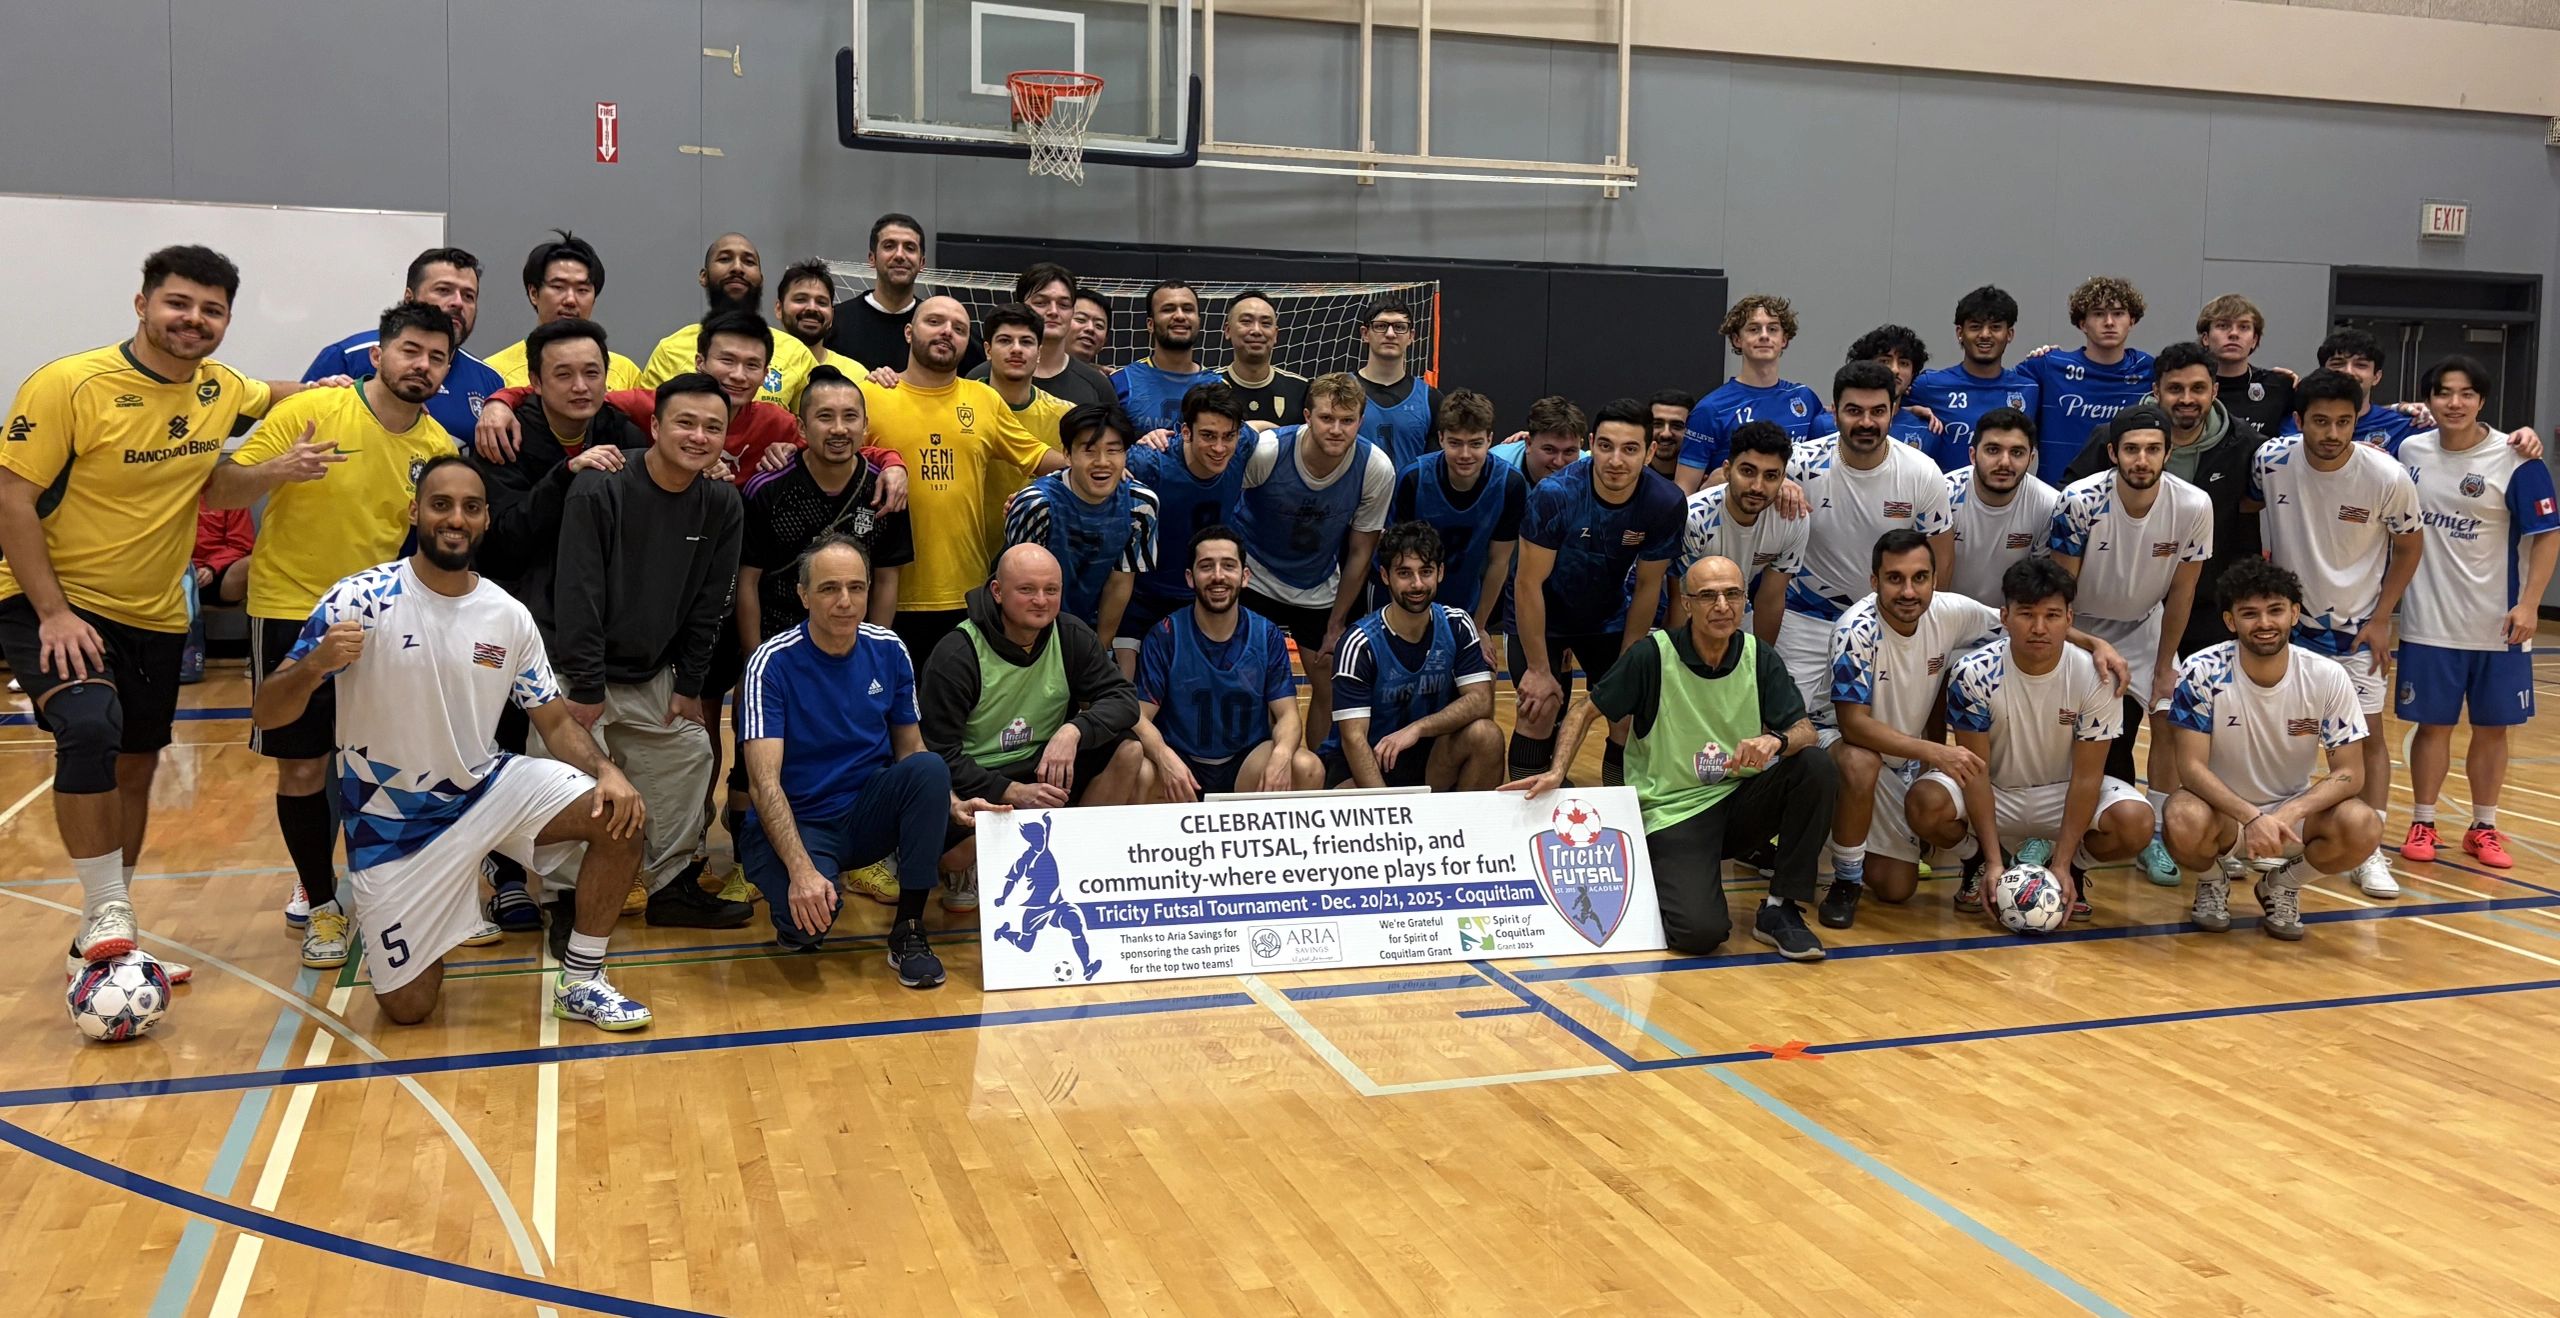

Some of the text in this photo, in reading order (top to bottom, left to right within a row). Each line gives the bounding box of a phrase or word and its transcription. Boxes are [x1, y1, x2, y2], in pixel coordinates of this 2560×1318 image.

[600, 107, 615, 117] FIRE
[2433, 207, 2464, 232] EXIT
[2065, 364, 2085, 380] 30
[1948, 392, 1968, 409] 23
[2059, 394, 2126, 418] Premi
[1735, 406, 1755, 424] 12
[189, 438, 221, 455] BRASIL
[921, 464, 954, 480] RAKI
[2449, 531, 2479, 540] ACADEMY
[1180, 806, 1413, 834] CELEBRATING WINTER
[1128, 829, 1465, 866] through FUTSAL, friendship, and
[1079, 854, 1516, 894] community-where everyone plays for fun!
[1551, 866, 1623, 886] FUTSAL
[1589, 884, 1624, 893] ACADEMY
[1096, 902, 1150, 925] Tricity
[1154, 898, 1204, 920] Futsal
[1207, 896, 1309, 917] Tournament
[1321, 892, 1357, 910] Dec.
[1360, 889, 1404, 911] 20/21,
[1407, 889, 1443, 908] 2025
[1455, 886, 1535, 907] Coquitlam
[1379, 916, 1444, 929] We're Grateful
[1493, 914, 1532, 927] Spirit of
[1120, 928, 1237, 944] Thanks to Aria Savings for
[1286, 928, 1336, 945] ARIA
[1389, 931, 1439, 945] for Spirit of
[1495, 928, 1545, 940] Coquitlam
[381, 922, 410, 969] 5
[1120, 943, 1240, 961] sponsoring the cash prizes
[1295, 946, 1329, 954] SAVINGS
[1379, 947, 1452, 960] Coquitlam Grant
[1497, 942, 1534, 951] Grant 2025
[1130, 958, 1234, 974] for the top two teams!
